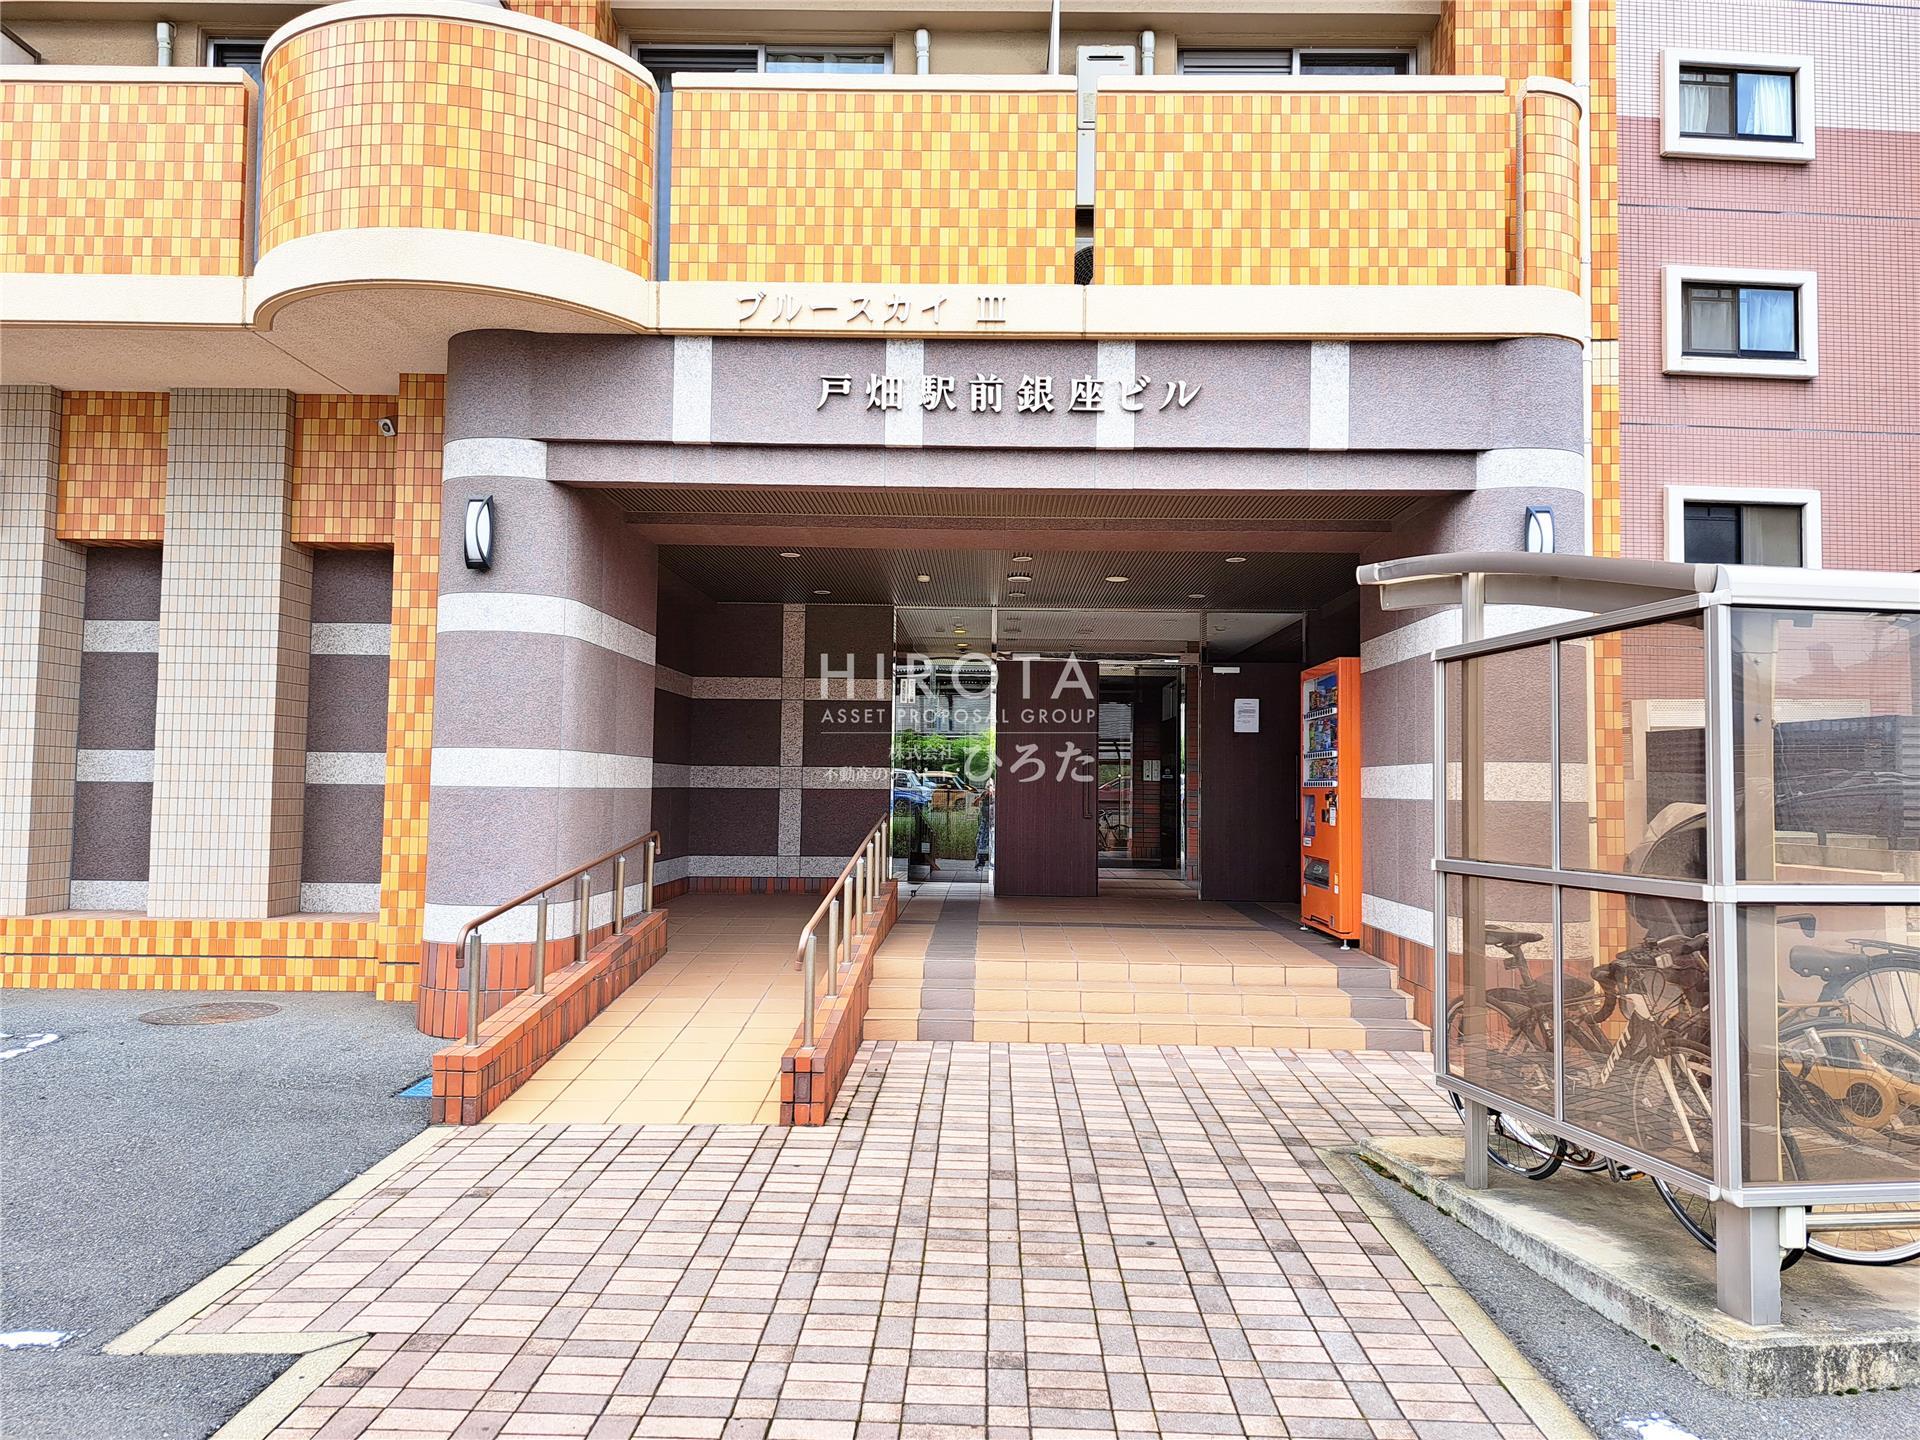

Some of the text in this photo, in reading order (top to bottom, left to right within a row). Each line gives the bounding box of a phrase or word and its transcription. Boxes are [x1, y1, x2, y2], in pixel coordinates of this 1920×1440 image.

[737, 293, 949, 324] ブルースカイ
[816, 372, 1202, 414] 戸畑駅前銀座ビル
